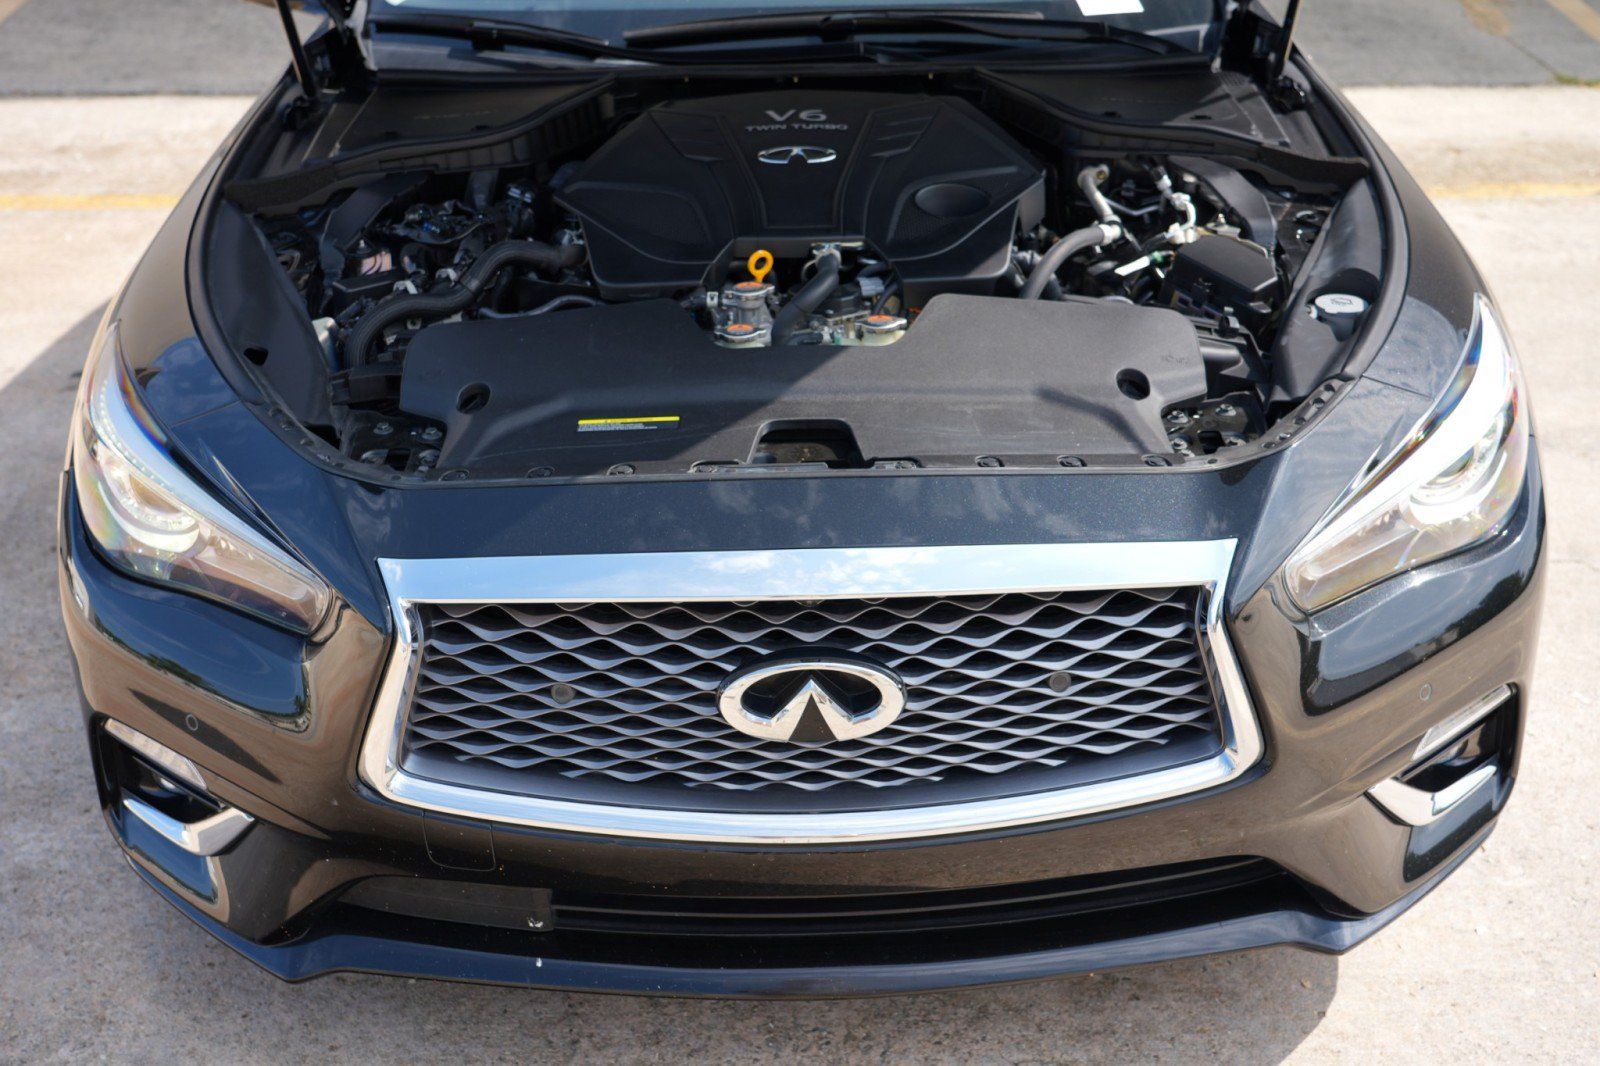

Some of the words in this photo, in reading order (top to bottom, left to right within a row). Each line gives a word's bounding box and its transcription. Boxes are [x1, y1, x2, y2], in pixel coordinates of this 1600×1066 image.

[765, 109, 827, 121] V6
[745, 124, 787, 132] TWIN
[792, 123, 848, 131] TURBO
